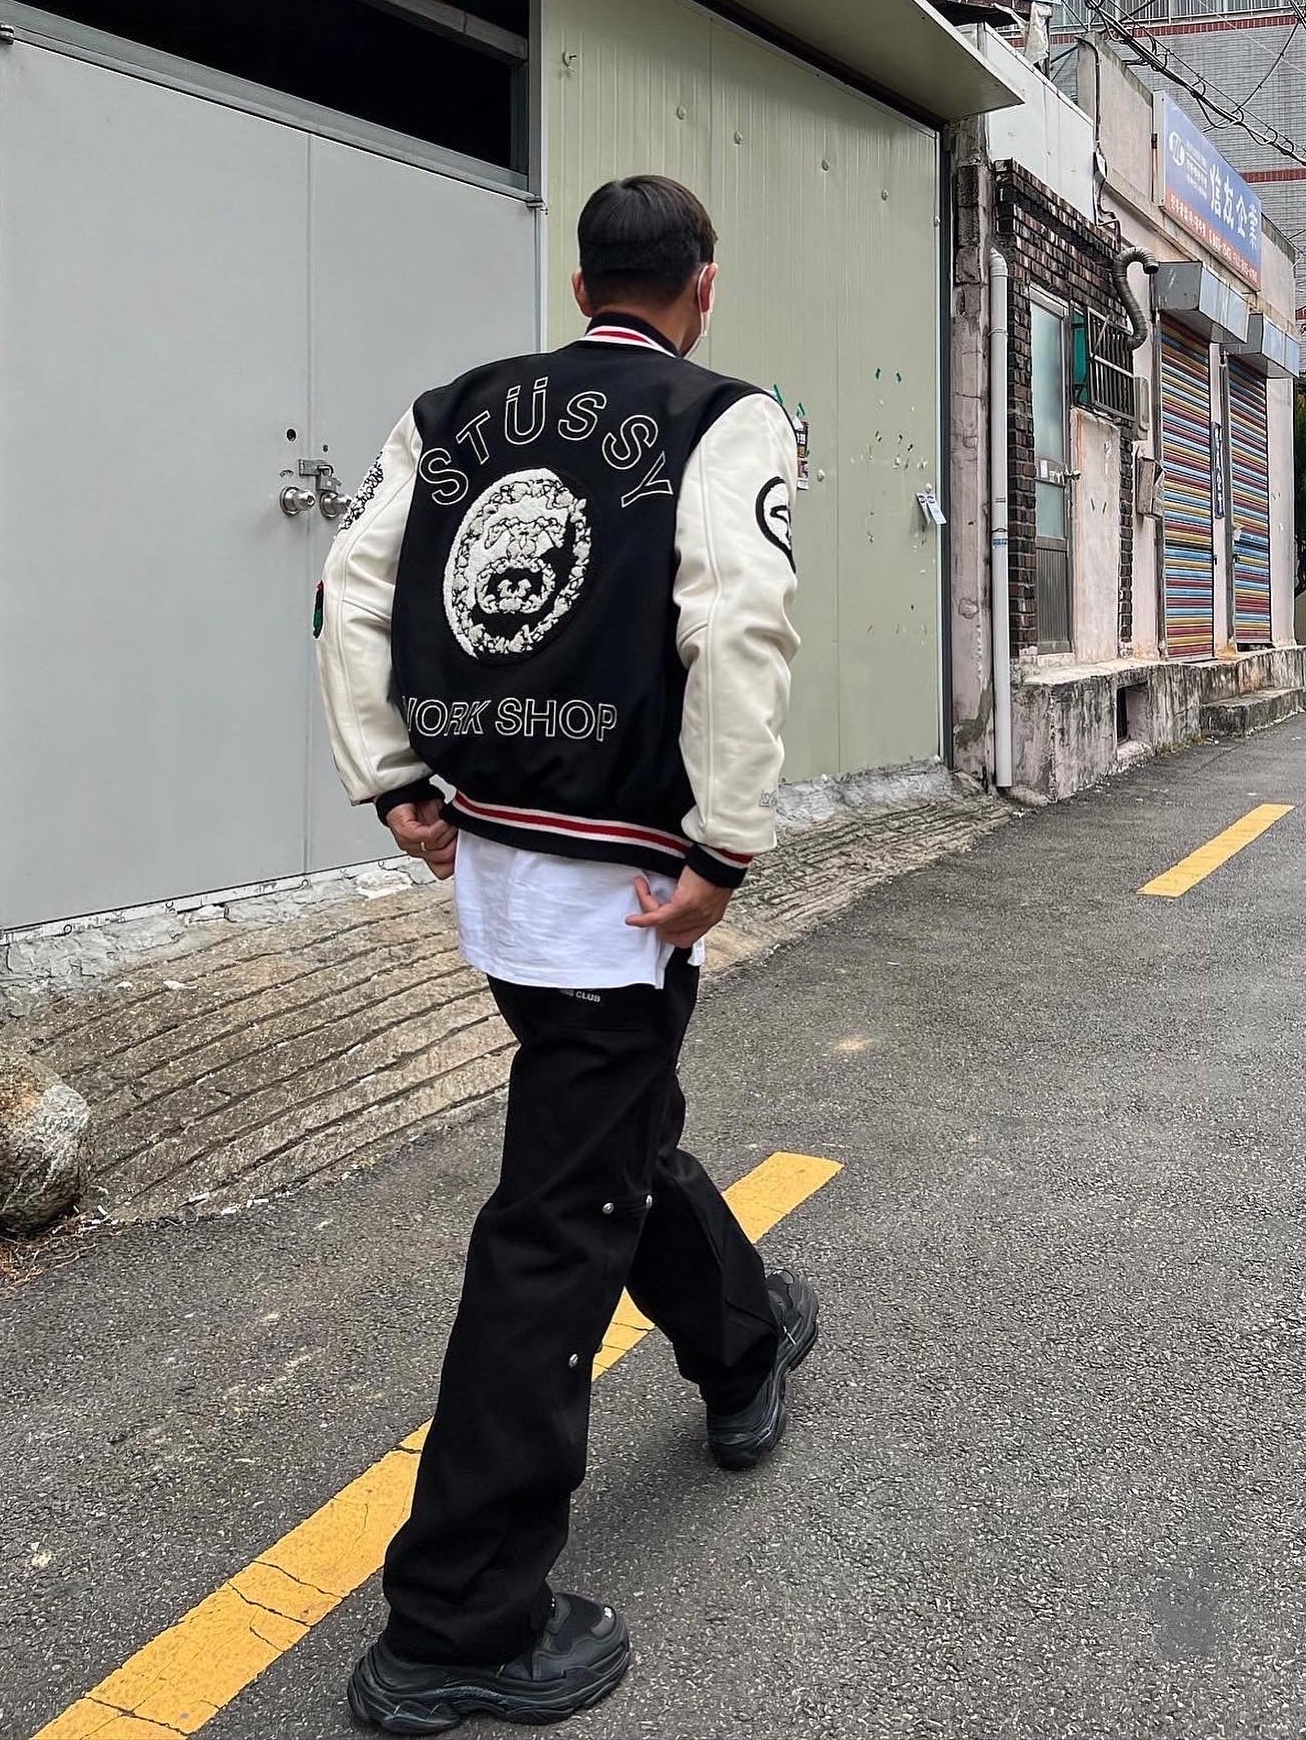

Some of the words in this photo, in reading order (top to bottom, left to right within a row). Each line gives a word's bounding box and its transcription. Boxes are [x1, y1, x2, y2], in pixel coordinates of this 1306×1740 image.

[418, 376, 674, 508] STÜSSY
[494, 697, 618, 742] SHOP
[575, 991, 601, 1002] CLUB
